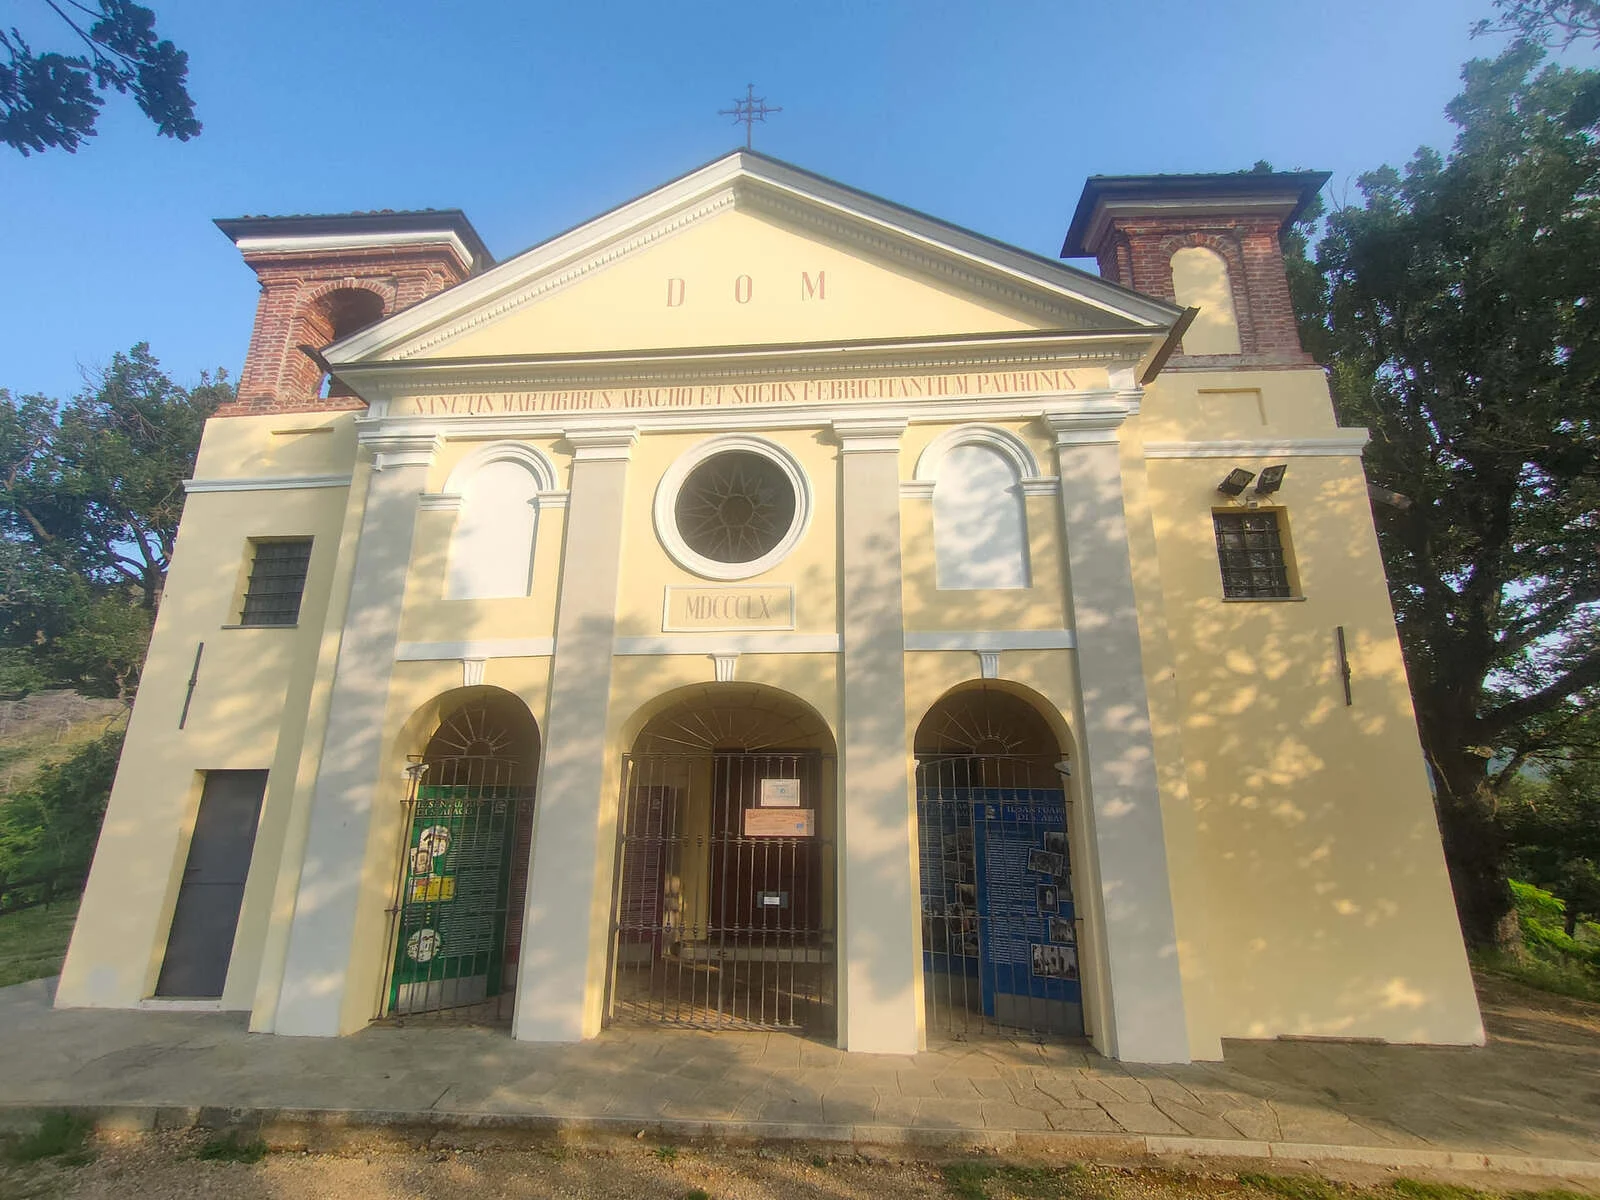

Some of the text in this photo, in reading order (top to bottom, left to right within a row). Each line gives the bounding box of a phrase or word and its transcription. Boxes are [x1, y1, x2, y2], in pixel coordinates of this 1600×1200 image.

[667, 270, 825, 307] D O M
[700, 386, 724, 406] ET
[732, 383, 796, 404] SOCIIS
[977, 370, 1077, 394] PATRONIS
[685, 595, 772, 620] MDCCCLX
